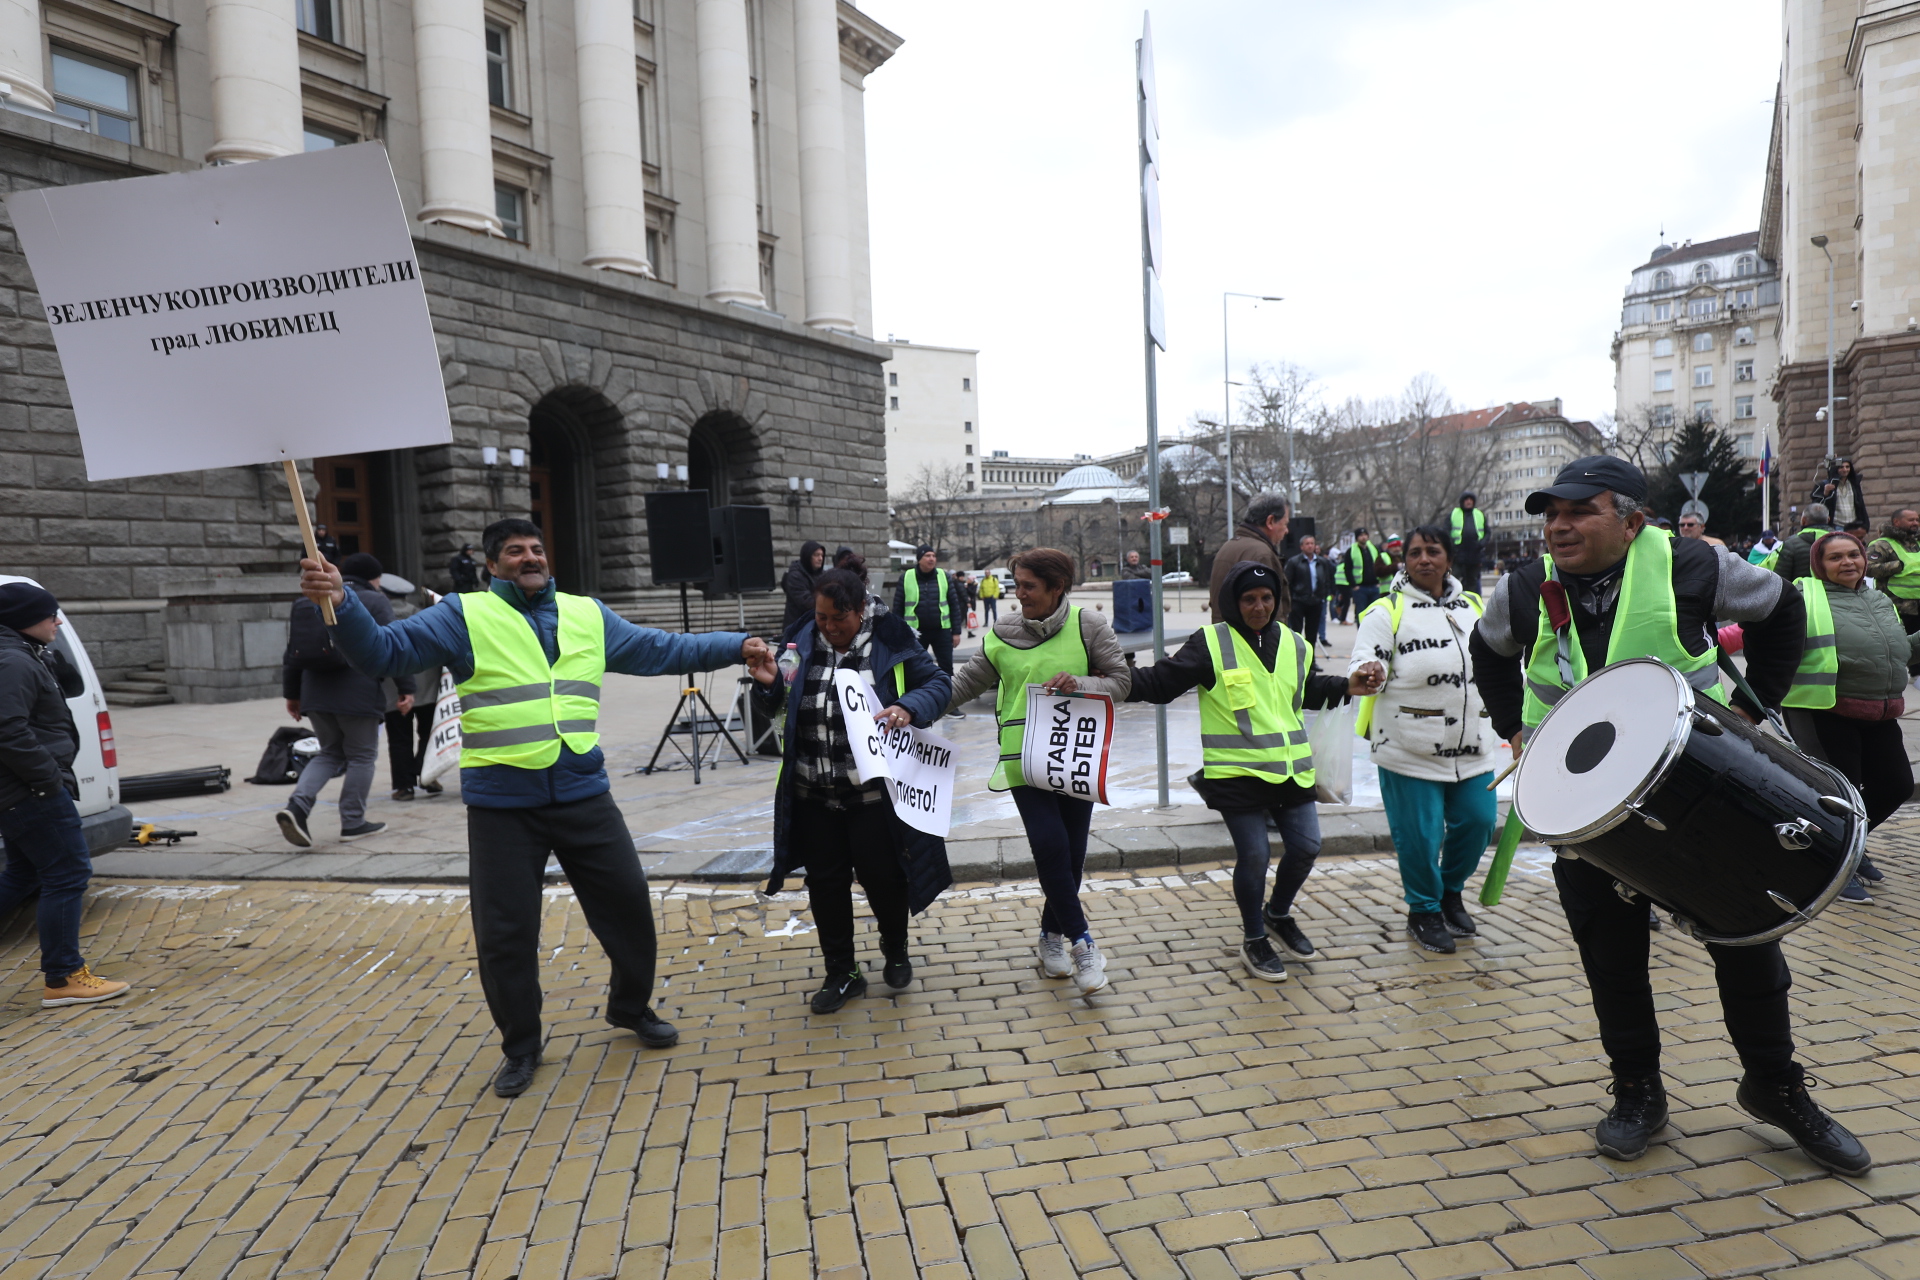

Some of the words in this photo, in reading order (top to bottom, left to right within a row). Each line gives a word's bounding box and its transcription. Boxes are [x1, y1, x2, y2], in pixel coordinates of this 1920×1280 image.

[47, 260, 416, 325] ЗЕЛЕНЧУКОПРОИЗВОДИТЕЛИ
[150, 333, 201, 356] град
[205, 310, 341, 345] ЛЮБИМЕЦ
[1071, 716, 1097, 796] ВЪТЕВ
